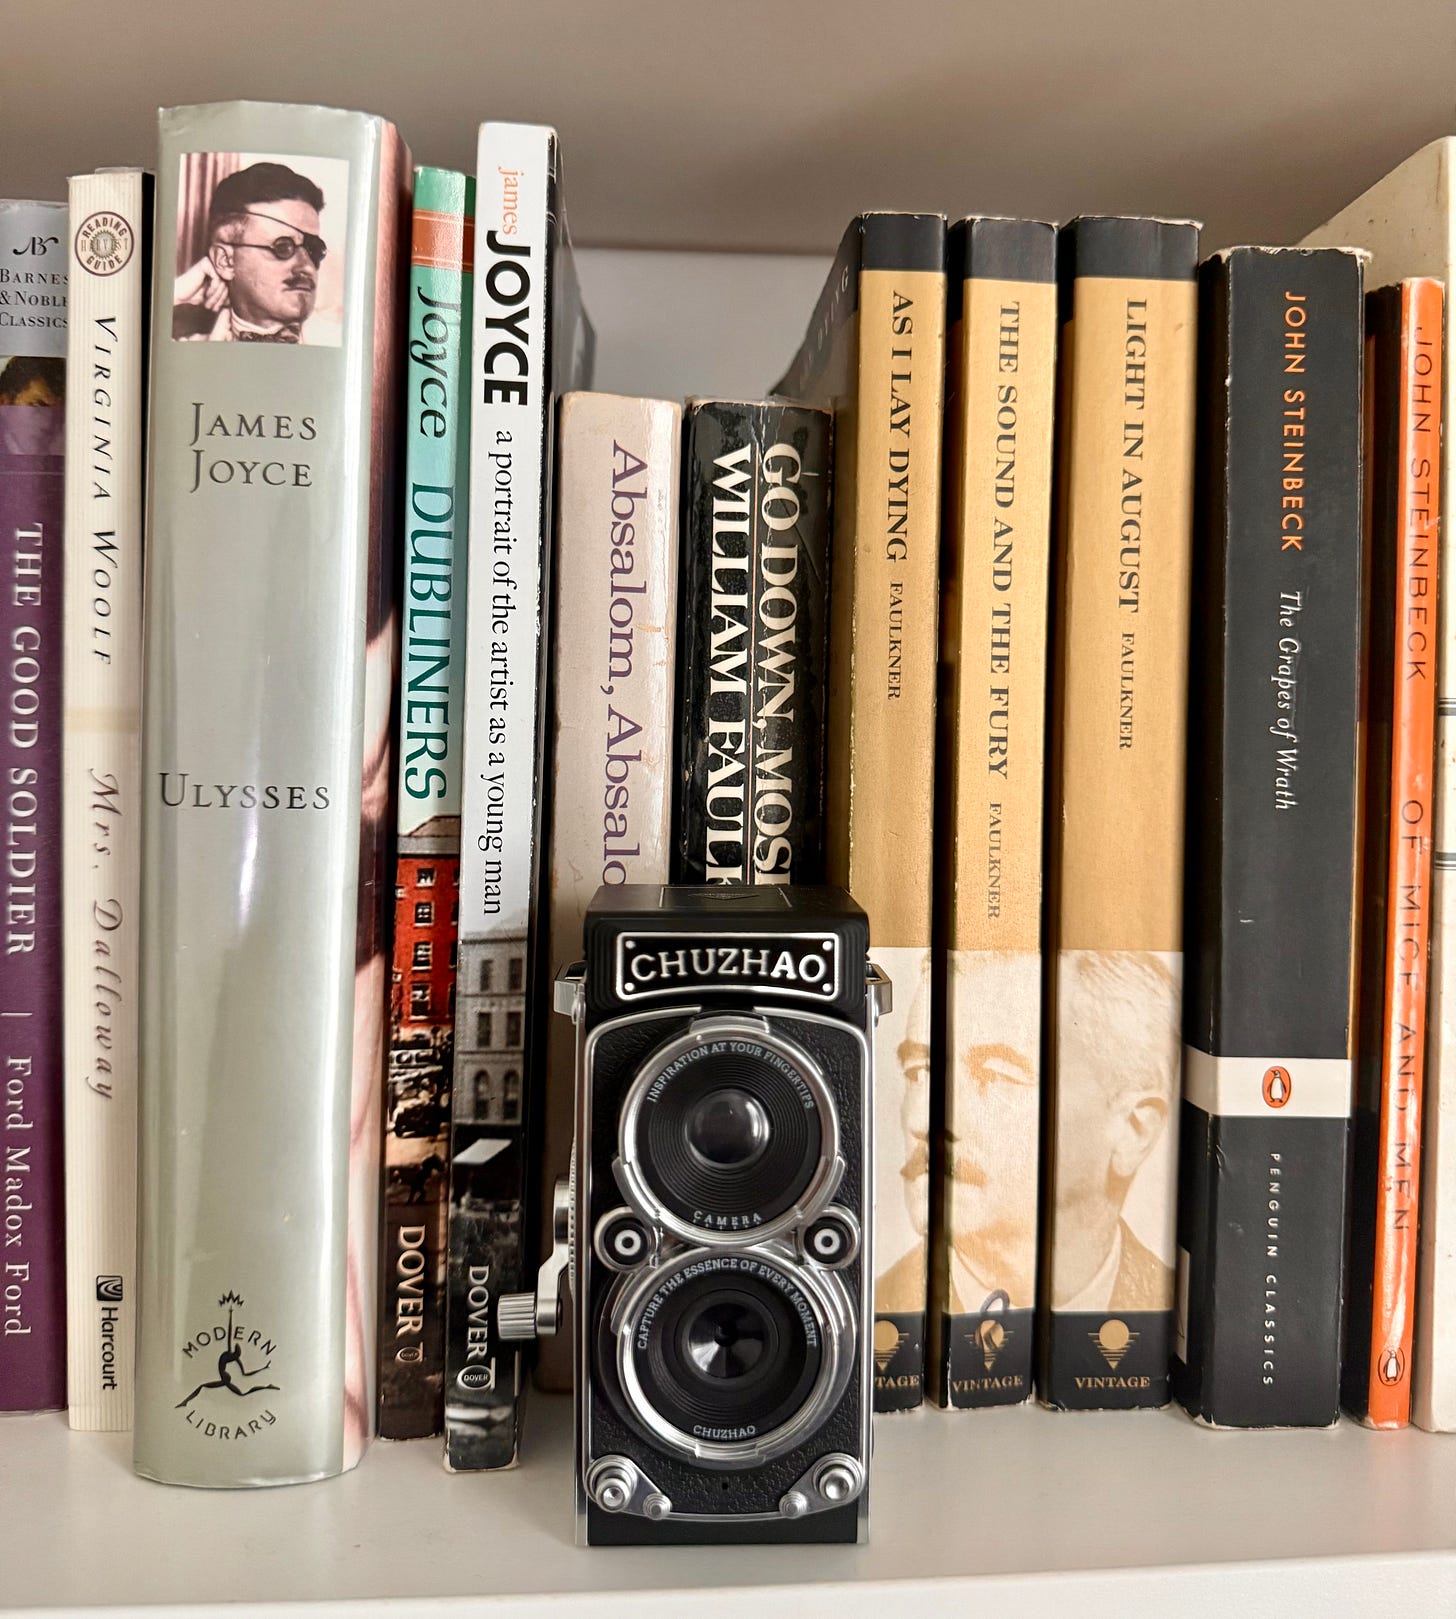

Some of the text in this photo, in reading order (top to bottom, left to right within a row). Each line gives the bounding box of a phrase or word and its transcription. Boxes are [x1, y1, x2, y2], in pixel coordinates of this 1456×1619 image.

[82, 217, 128, 239] READING
[497, 166, 524, 235] james
[0, 268, 68, 285] BARNES
[86, 255, 123, 271] GUIDE
[483, 230, 531, 406] JOYCE
[190, 402, 318, 446] JAMES
[1413, 327, 1433, 433] JOHN
[93, 315, 119, 665] VIRGINIA WOOLF
[190, 450, 313, 492] JOYCE
[760, 443, 800, 531] GO
[886, 290, 914, 700] AS I LAY DYING FAULKNER
[404, 285, 459, 800] Joyce DUBLINERS
[600, 439, 650, 695] Absalom,
[708, 446, 753, 696] WILLIAM
[1118, 299, 1148, 750] LIGHT IN AUGUST FAULKNER
[1269, 291, 1306, 810] JOHN STEINBECK The Grapes of Wrath
[1406, 458, 1431, 681] STEINBECK
[753, 544, 799, 730] DOWN,
[988, 301, 1020, 920] THE SOUND AND THE FURY FAULKNER
[478, 431, 522, 915] a portrait of the artist as a young man
[6, 522, 44, 956] THE GOOD SOLDIER
[159, 772, 331, 810] ULYSSES
[1401, 800, 1424, 854] OF
[85, 768, 124, 1099] Mrs. Dalloway
[630, 947, 826, 982] CHUZHAO
[646, 1041, 815, 1109] INSPIRATION AT YOUR FINGERTIPS
[4, 1056, 34, 1336] Ford Madox Ford
[694, 1210, 762, 1226] CAMERA
[395, 1225, 425, 1341] DOVER
[467, 1265, 489, 1361] DOVER
[637, 1258, 818, 1350] CAPTURE THE ESSENCE OF EVERY MOMENT
[1263, 1153, 1280, 1385] PENGUIN CLASSICS
[102, 1306, 122, 1390] Harcourt
[182, 1324, 278, 1358] MODERN
[952, 1375, 1023, 1393] VINTAGE
[1074, 1376, 1151, 1389] VINTAGE
[186, 1408, 278, 1440] LIBRARY
[693, 1424, 757, 1439] CHUZHAO
